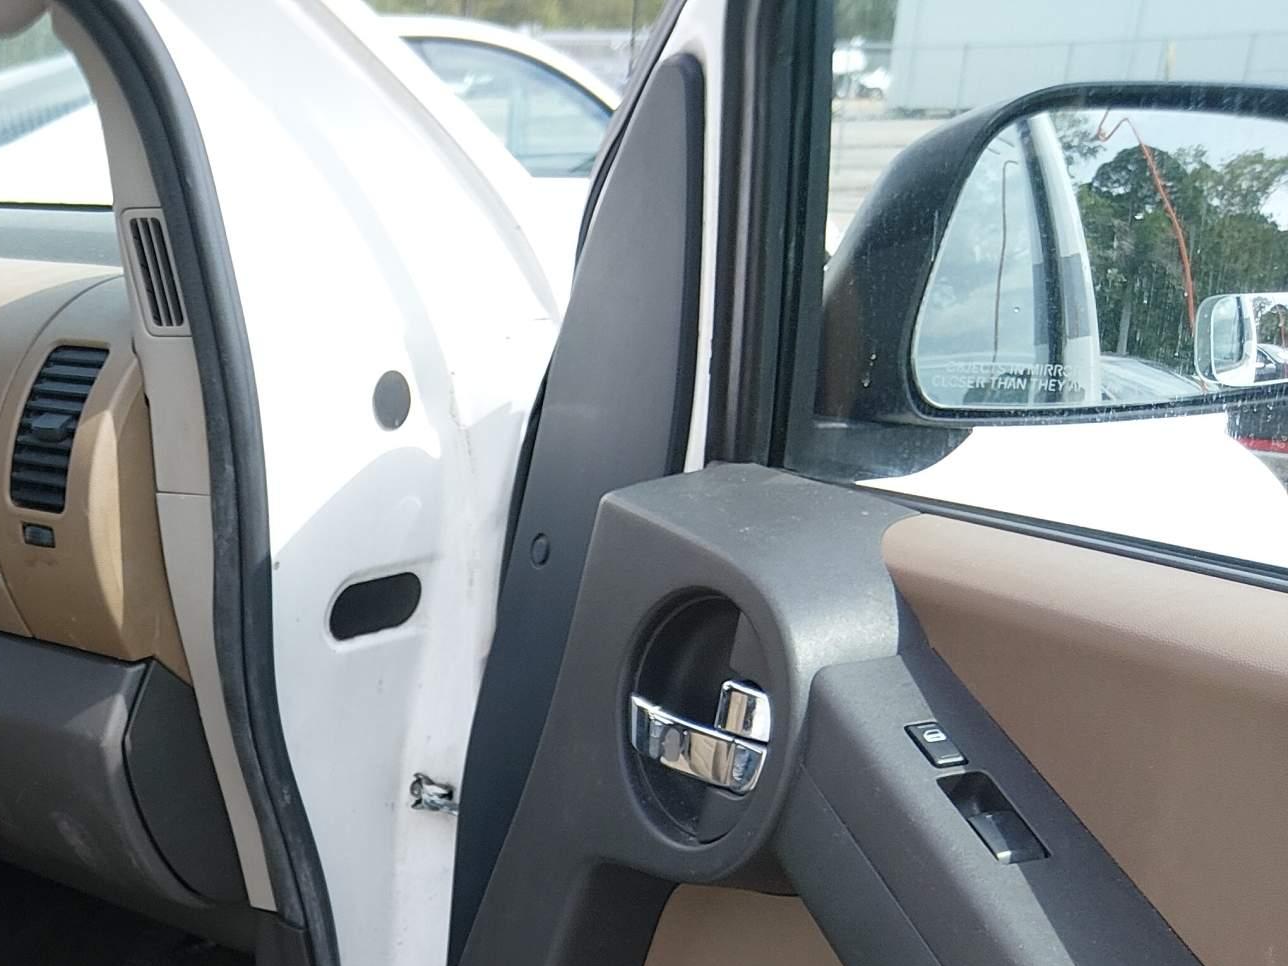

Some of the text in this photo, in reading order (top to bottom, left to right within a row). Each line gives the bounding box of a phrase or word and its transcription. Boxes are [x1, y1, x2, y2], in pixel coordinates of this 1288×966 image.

[933, 375, 986, 389] CLOSER
[990, 376, 1028, 390] THAN
[1031, 378, 1066, 392] THEY
